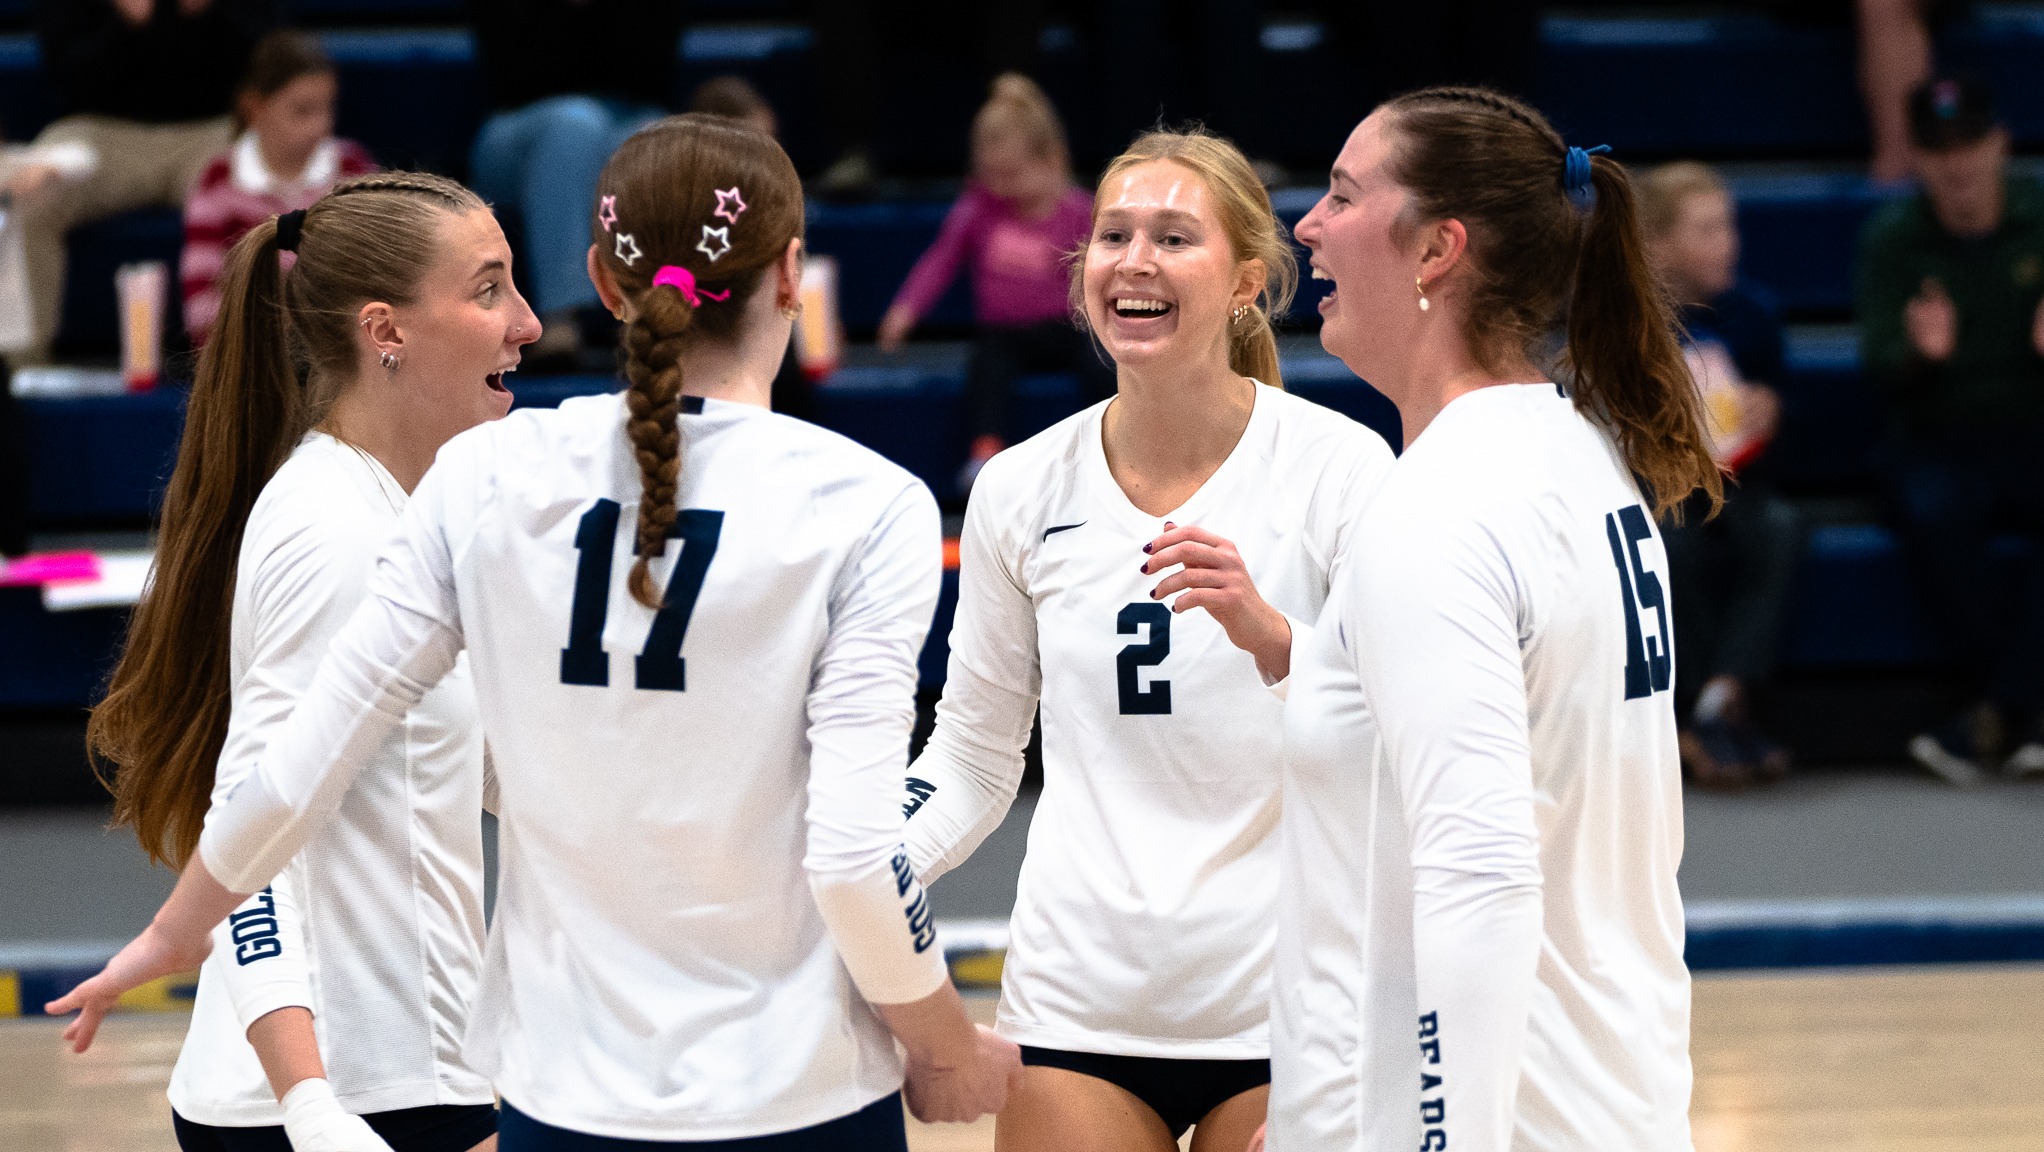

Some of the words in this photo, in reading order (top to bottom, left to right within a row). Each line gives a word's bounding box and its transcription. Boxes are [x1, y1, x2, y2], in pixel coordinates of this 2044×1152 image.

[560, 498, 726, 692] 17
[1116, 602, 1172, 715] 2
[1605, 504, 1672, 701] 15
[229, 885, 282, 966] GOL
